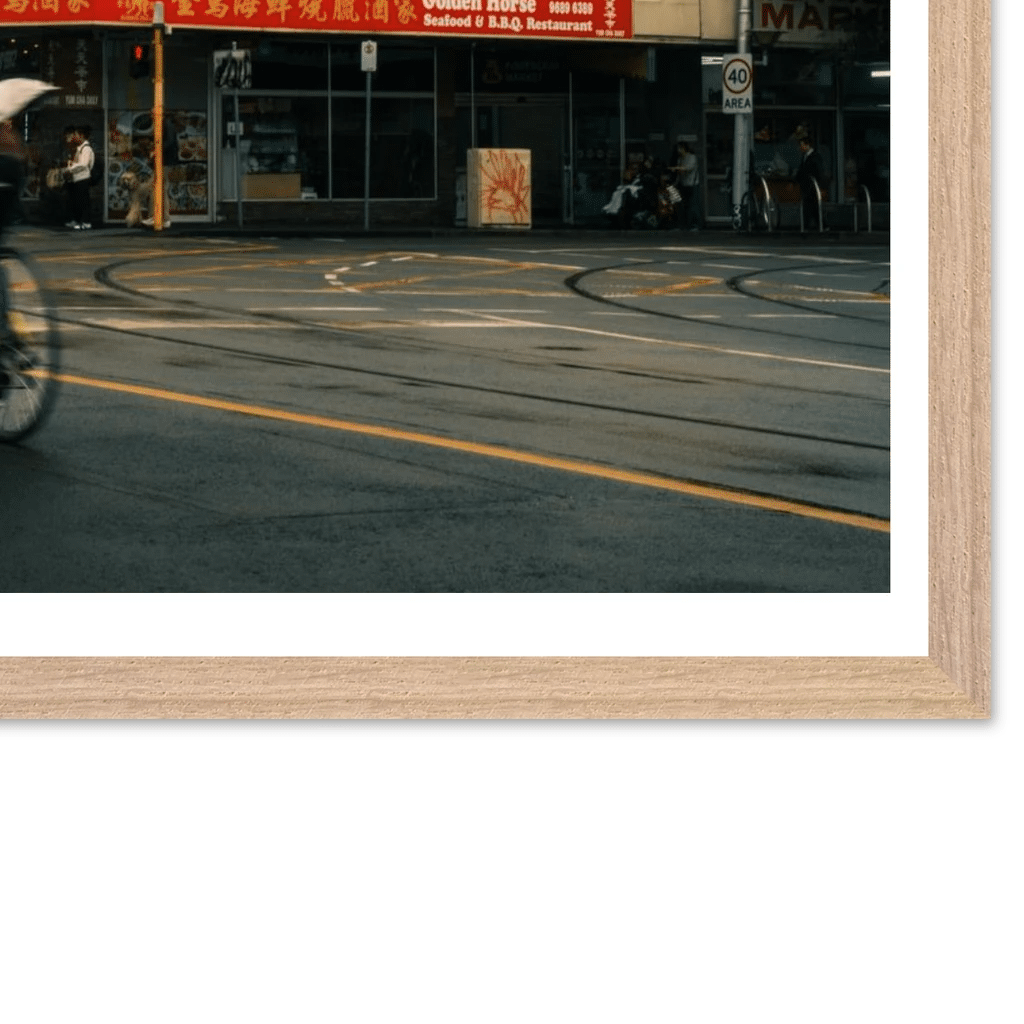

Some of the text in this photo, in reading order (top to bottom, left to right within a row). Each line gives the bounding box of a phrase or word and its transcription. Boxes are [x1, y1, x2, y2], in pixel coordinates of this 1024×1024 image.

[423, 13, 472, 28] Seafood
[526, 17, 593, 32] Restaurant
[727, 68, 748, 85] 40
[725, 97, 752, 110] AREA
